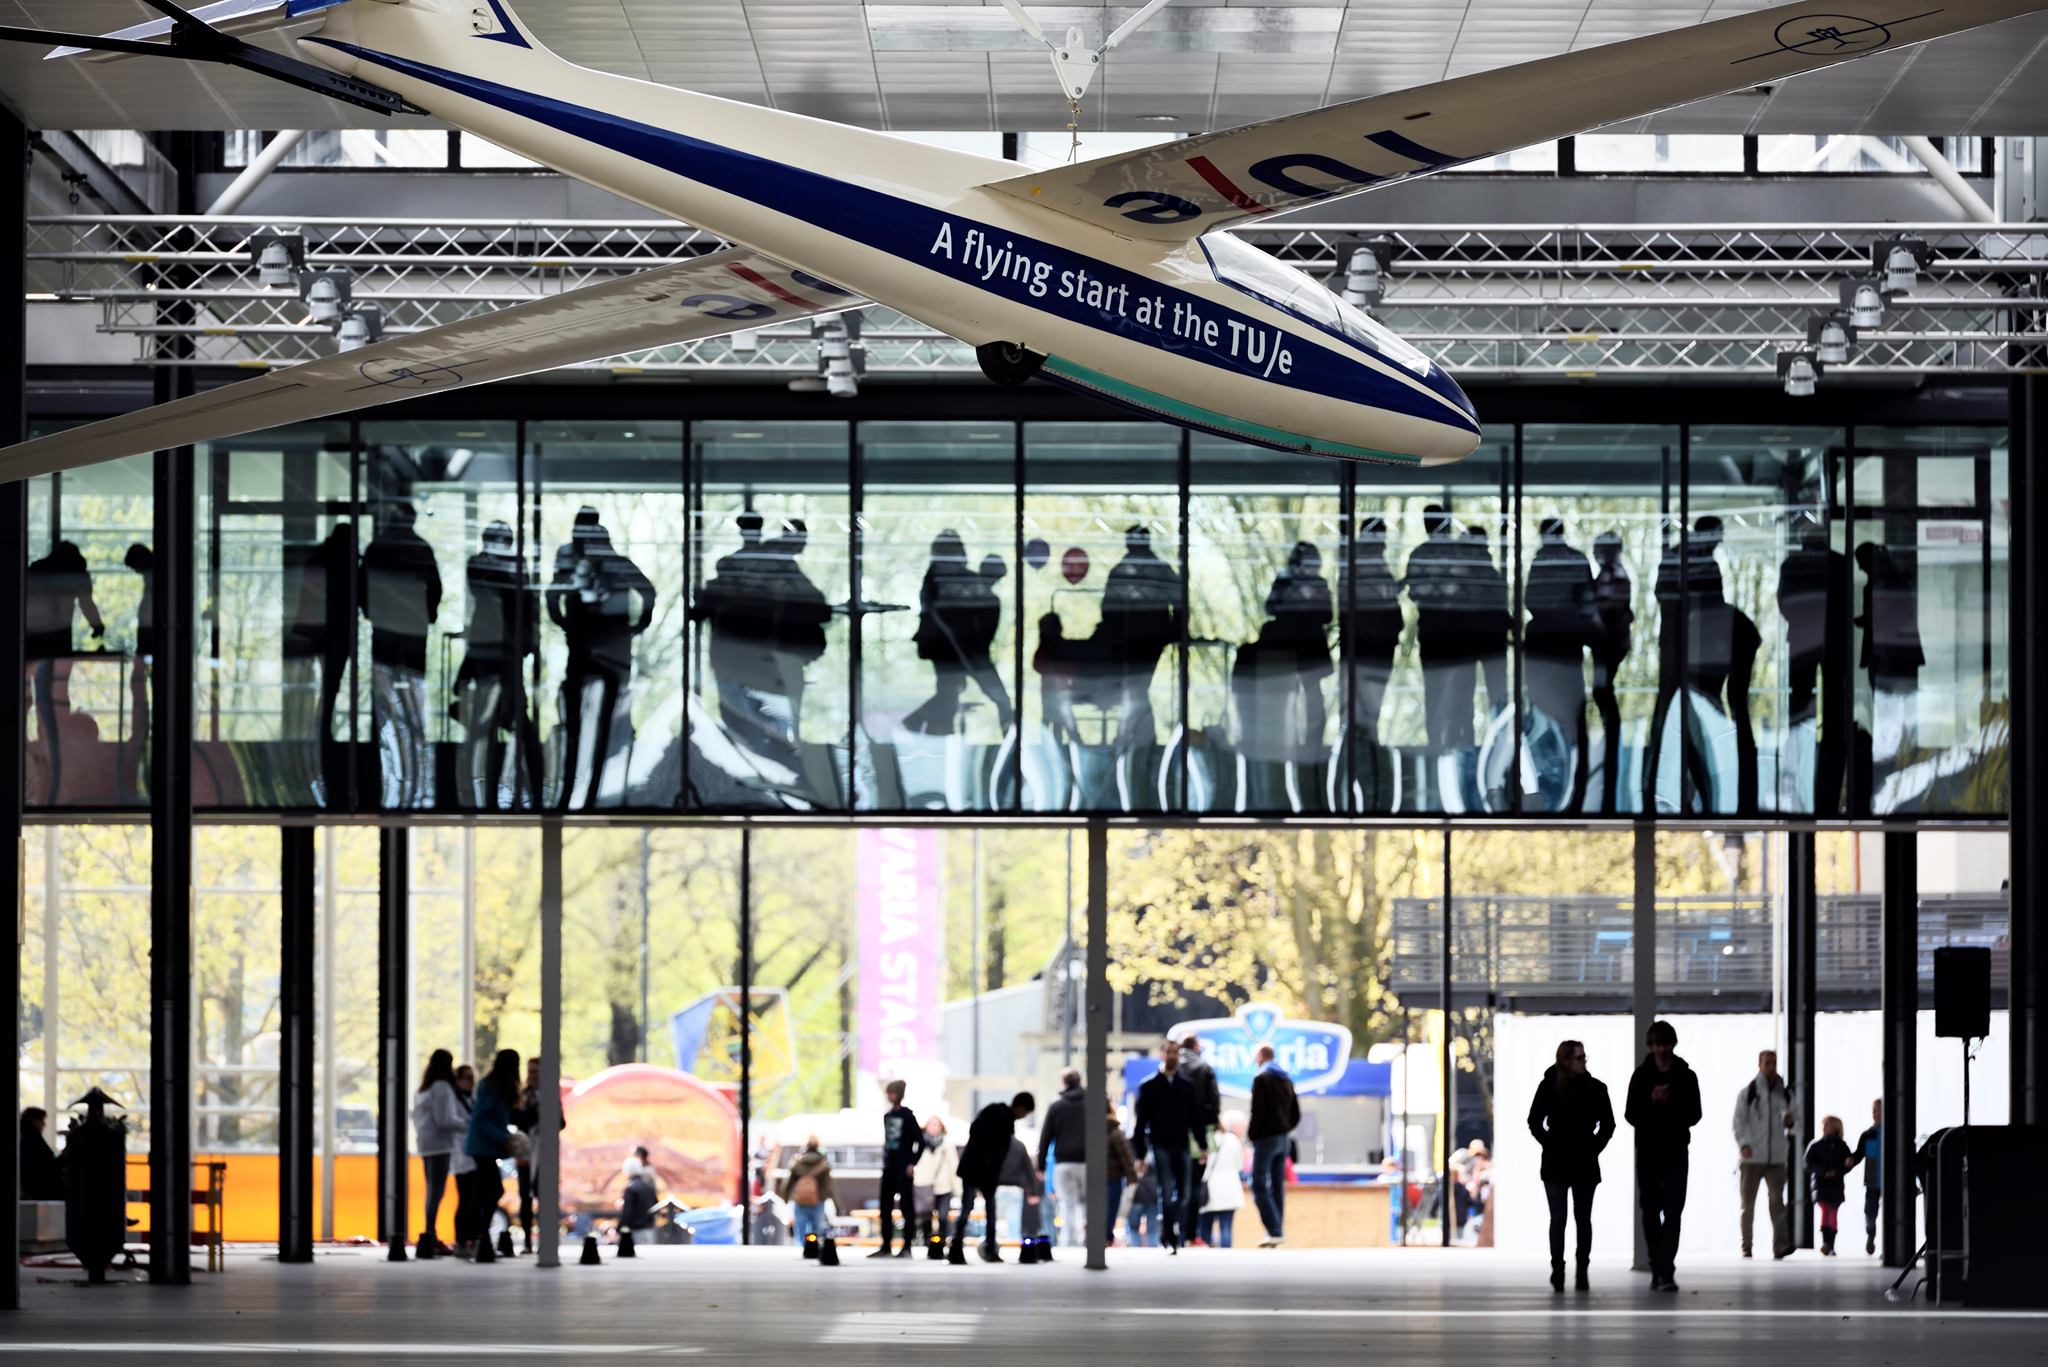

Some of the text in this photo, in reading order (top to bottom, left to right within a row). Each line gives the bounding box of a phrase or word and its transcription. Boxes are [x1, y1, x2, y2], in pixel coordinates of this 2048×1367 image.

[930, 222, 1293, 378] A flying start at the TU/e
